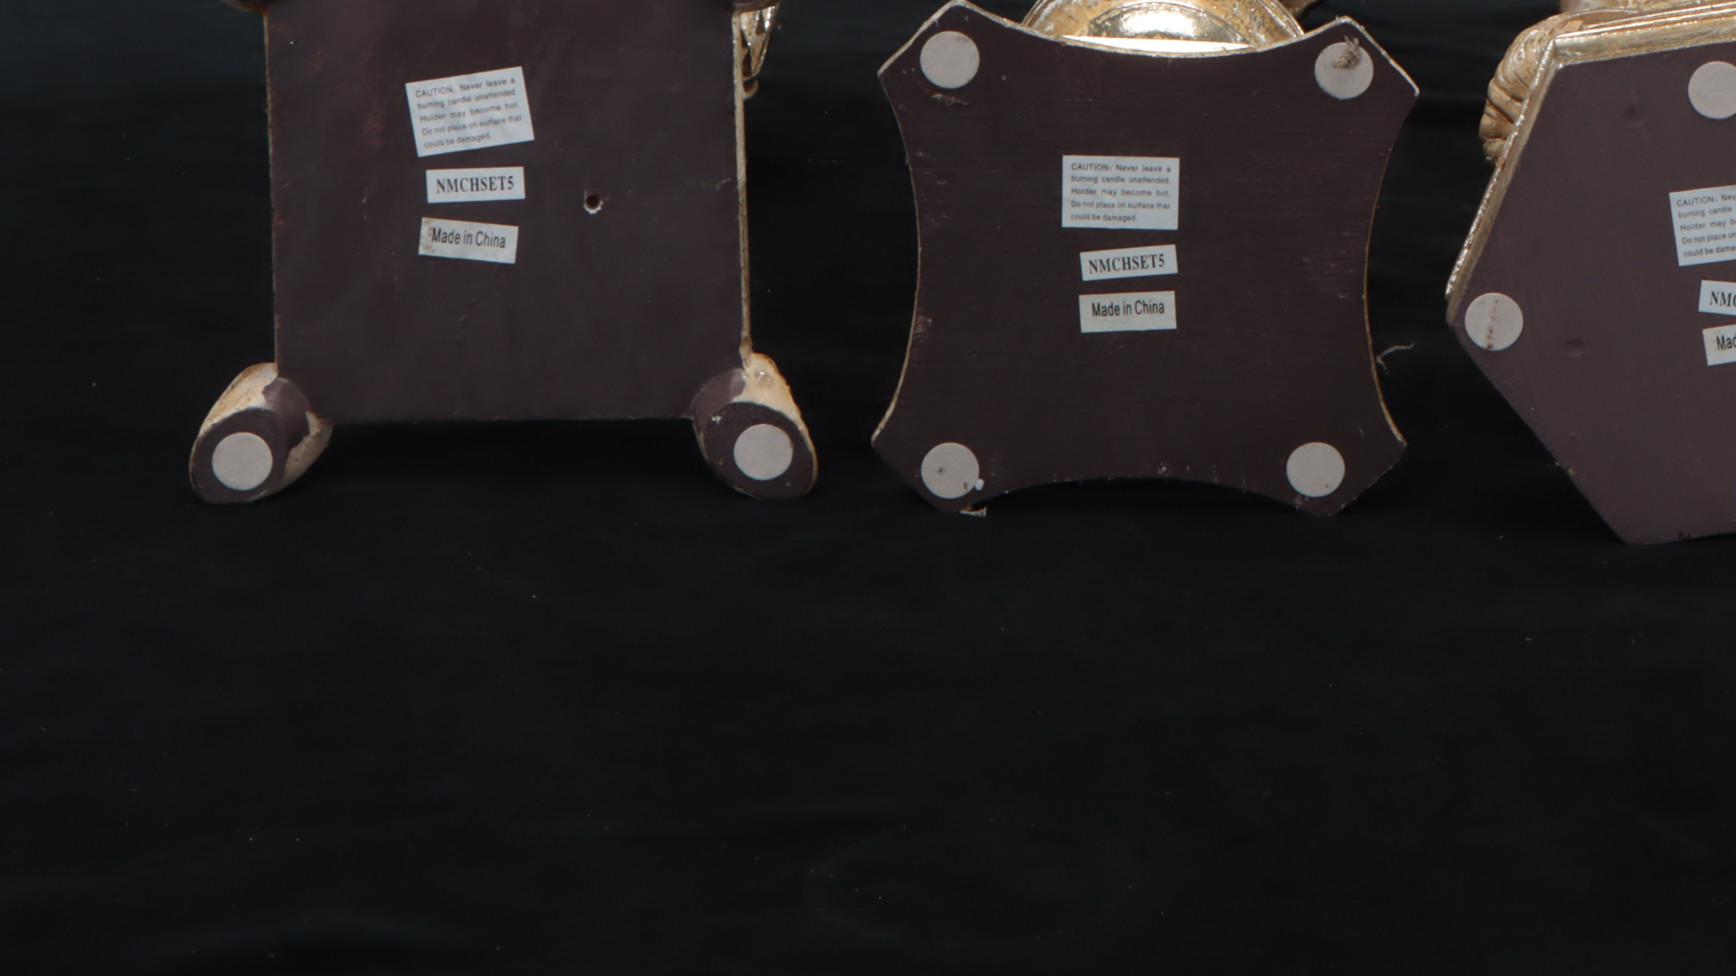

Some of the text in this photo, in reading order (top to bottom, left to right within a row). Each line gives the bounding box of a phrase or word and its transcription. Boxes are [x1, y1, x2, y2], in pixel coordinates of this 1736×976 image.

[436, 176, 514, 194] NMCHSET5
[432, 227, 506, 249] Made in China
[1088, 254, 1165, 274] NMCHSET5
[1092, 299, 1164, 317] Made in China
